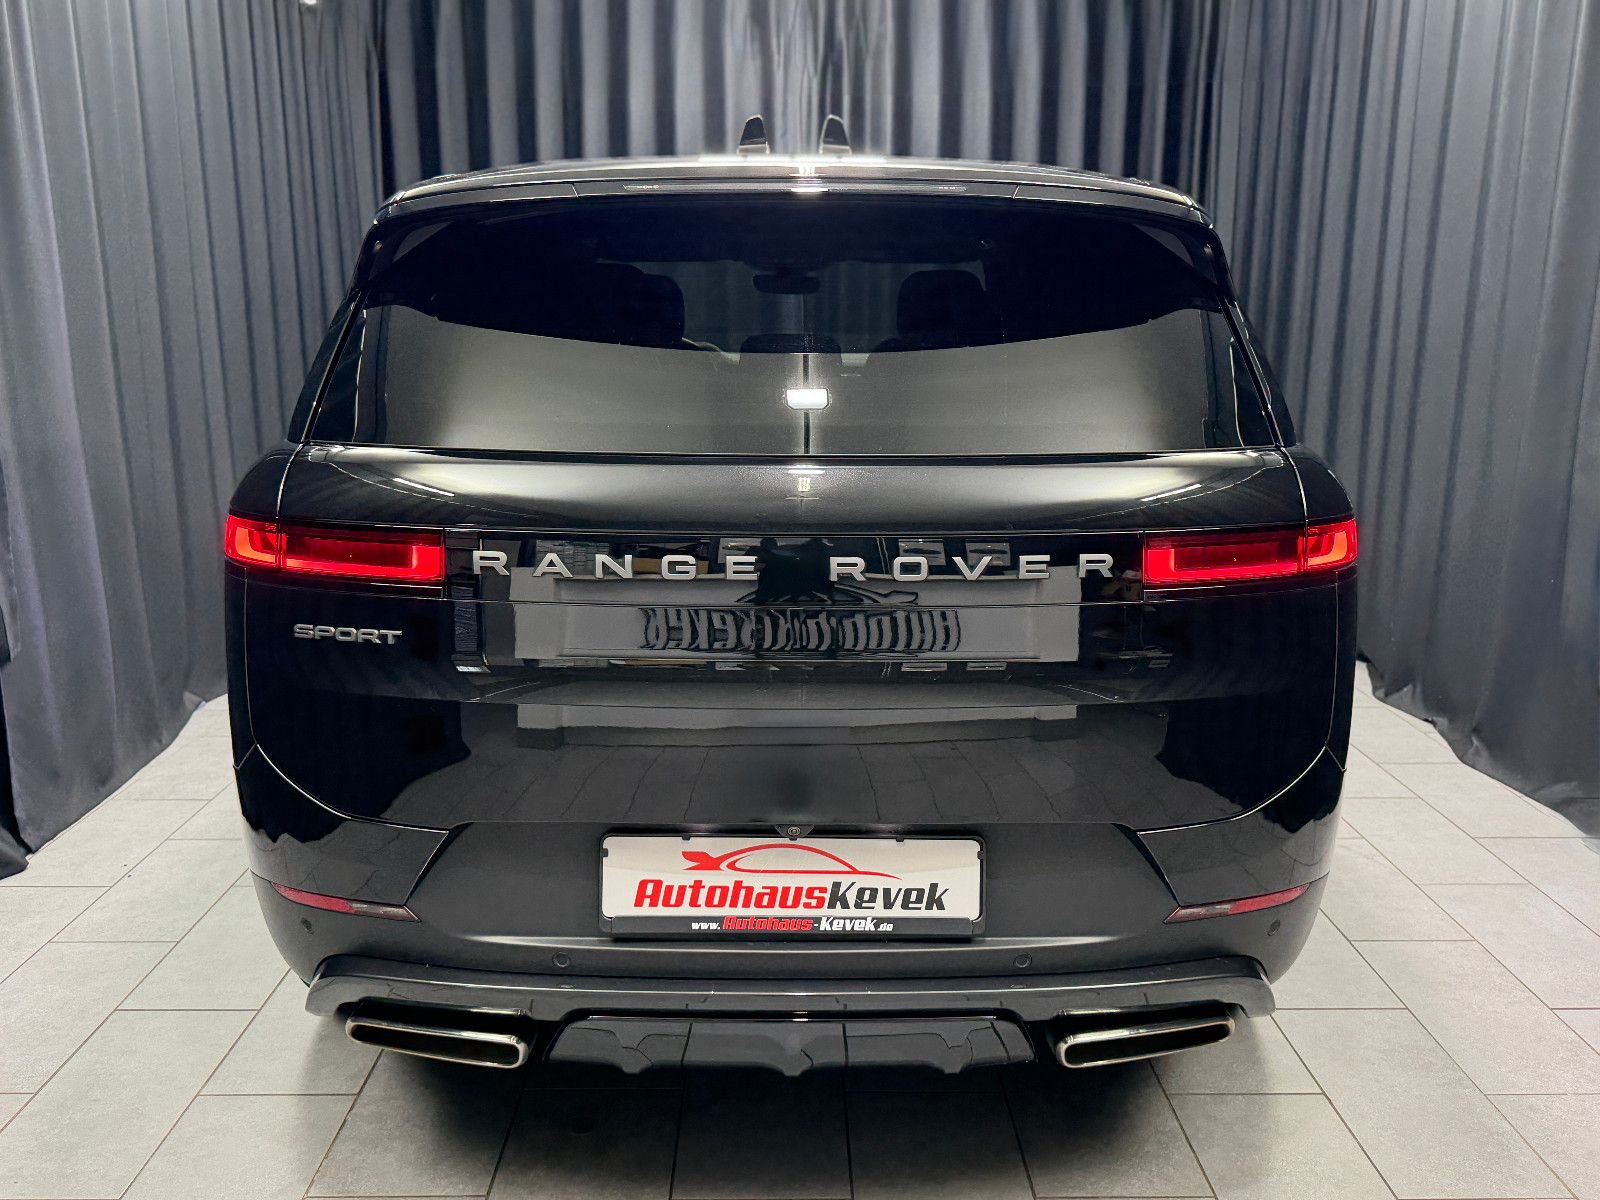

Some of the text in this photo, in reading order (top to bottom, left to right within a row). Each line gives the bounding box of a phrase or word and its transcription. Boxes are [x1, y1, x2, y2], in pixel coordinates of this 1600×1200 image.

[472, 549, 1115, 583] RANGE ROVER
[293, 623, 403, 645] SPORT
